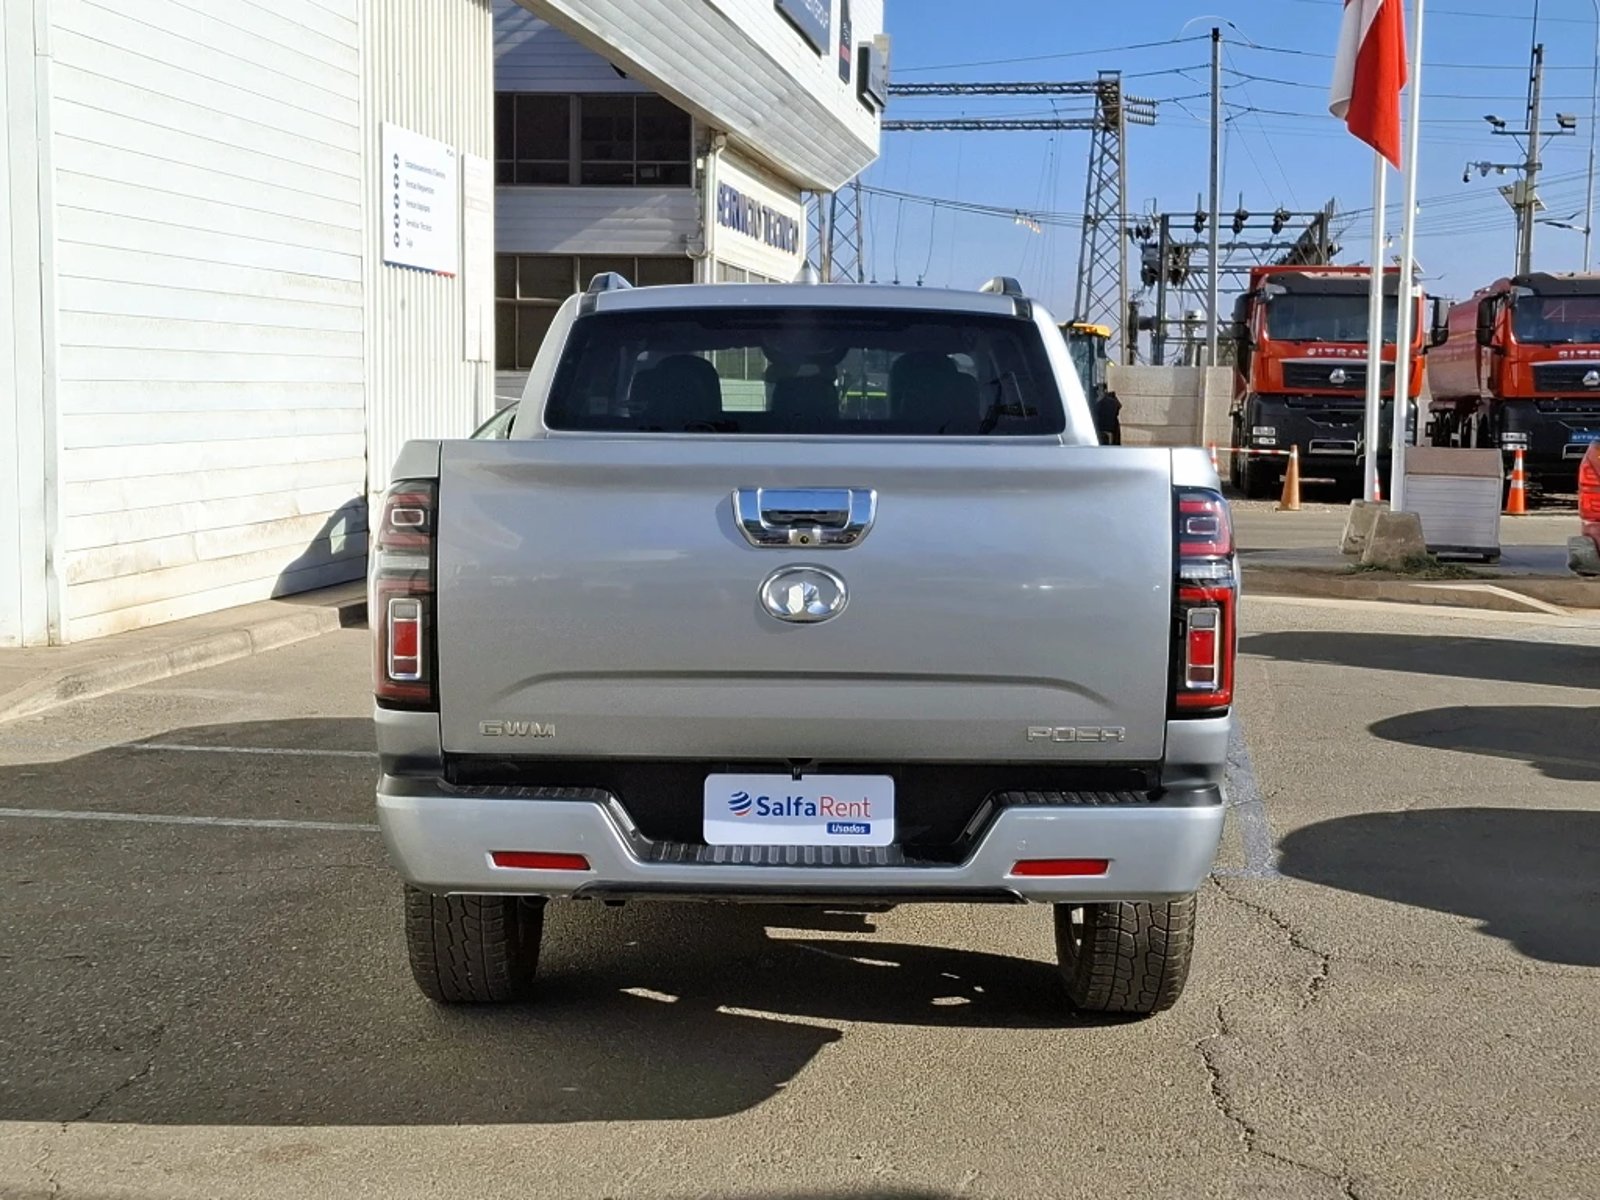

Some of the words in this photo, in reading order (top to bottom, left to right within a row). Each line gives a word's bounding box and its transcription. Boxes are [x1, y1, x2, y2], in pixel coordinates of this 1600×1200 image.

[717, 180, 762, 240] SERVICIO
[480, 720, 556, 738] GWM
[1027, 726, 1126, 742] POER
[756, 796, 871, 818] SalfaRent
[831, 822, 866, 834] Usados
